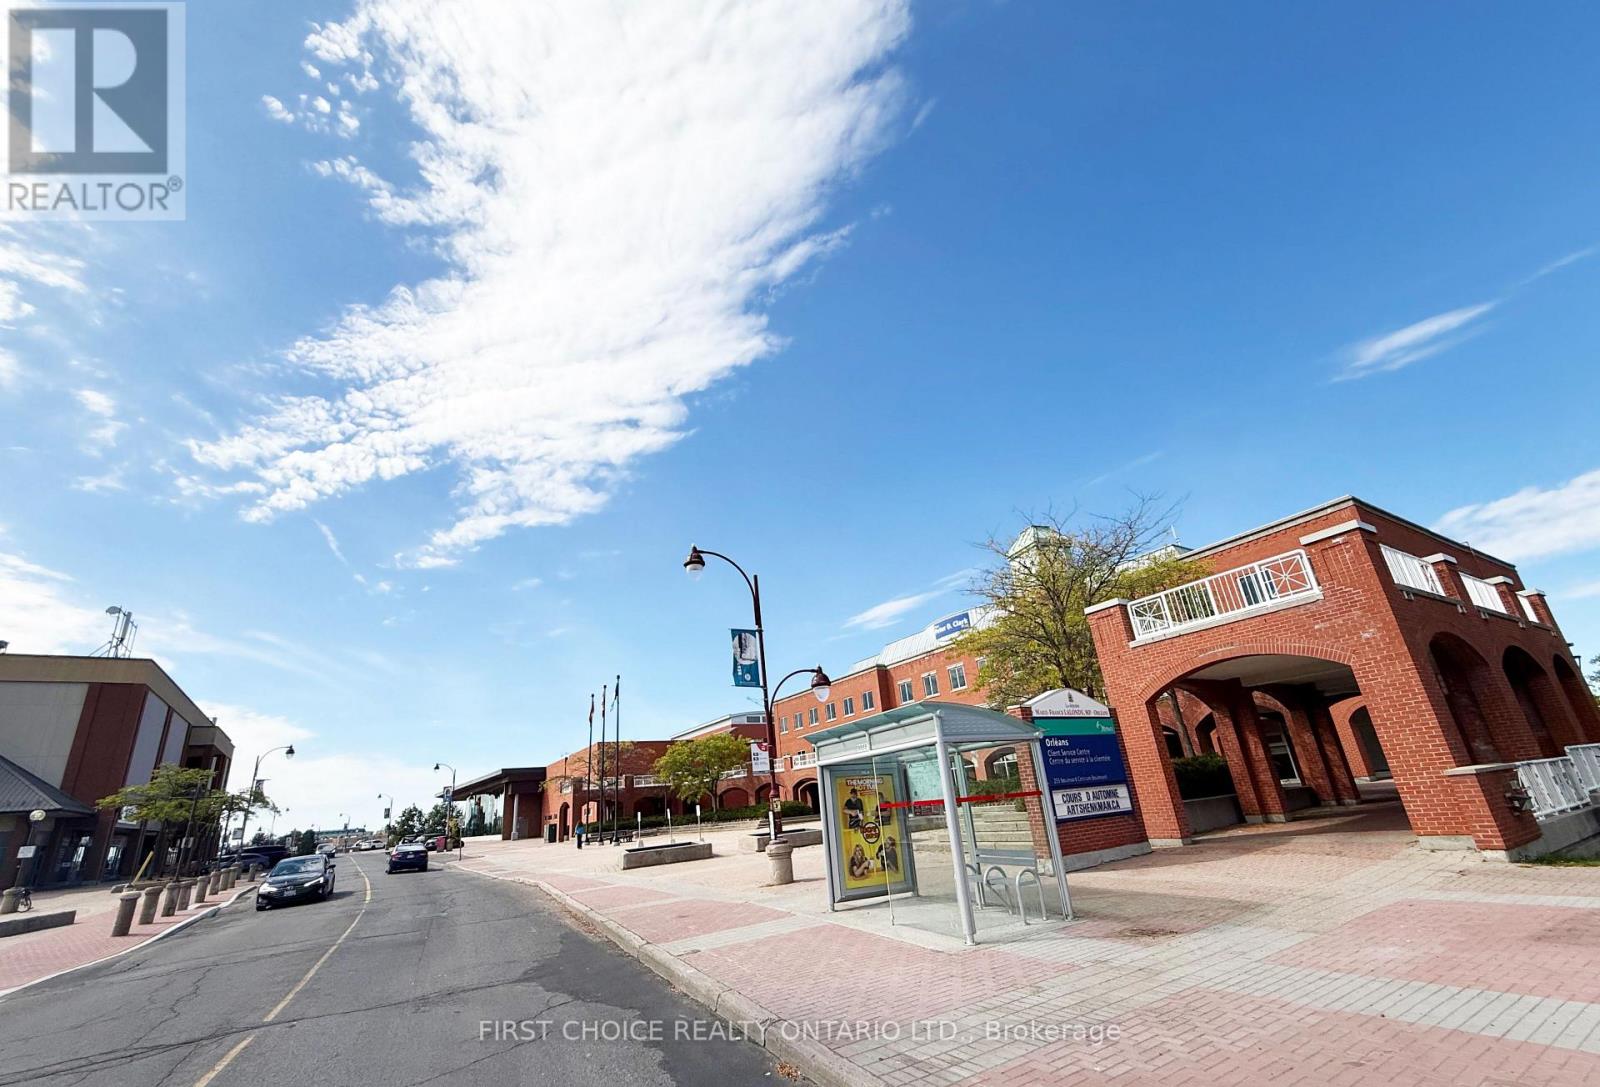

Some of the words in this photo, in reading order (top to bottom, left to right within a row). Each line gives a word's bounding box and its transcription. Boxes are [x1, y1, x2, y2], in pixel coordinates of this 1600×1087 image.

[1045, 738, 1069, 747] Orléans
[1047, 749, 1060, 757] Client
[1049, 757, 1064, 765] Centre
[1061, 792, 1083, 804] COURS
[1085, 791, 1091, 801] D
[1092, 788, 1120, 800] AUTOMNE
[1066, 799, 1120, 816] ARTSHENKMAN.CA
